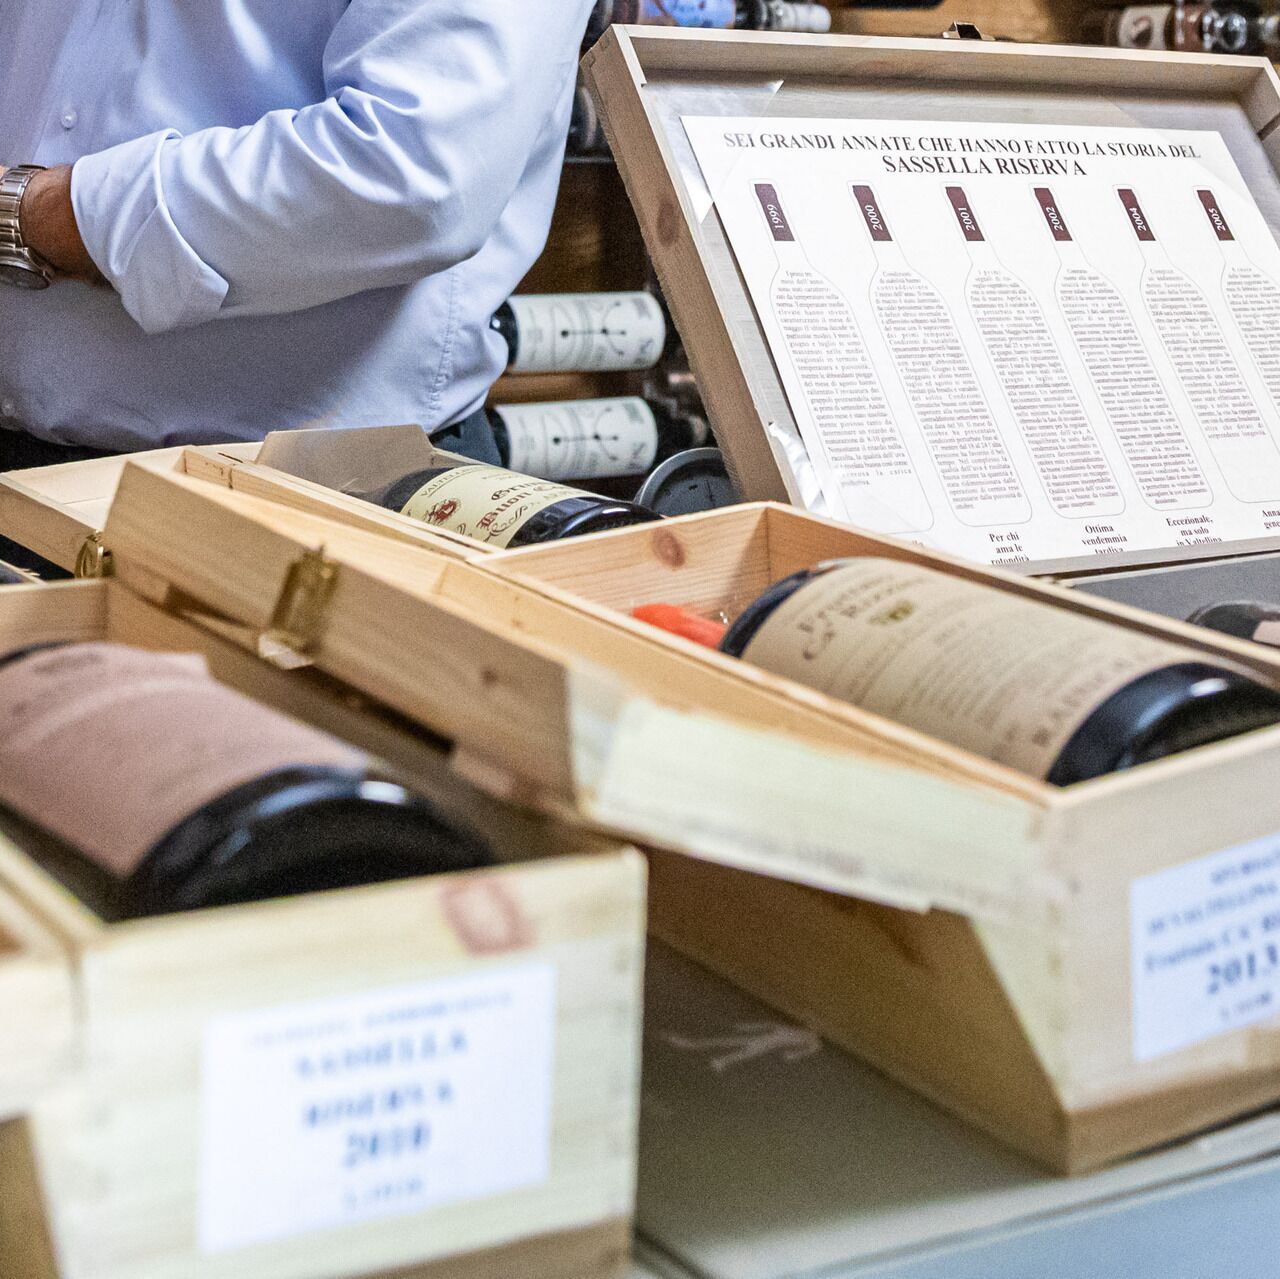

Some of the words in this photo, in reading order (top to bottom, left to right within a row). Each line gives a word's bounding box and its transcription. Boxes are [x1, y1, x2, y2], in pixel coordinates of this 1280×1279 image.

[723, 133, 755, 148] SEI
[760, 133, 835, 150] GRANDI
[841, 135, 915, 151] ANNATE
[918, 137, 956, 152] CHE
[959, 138, 1021, 154] HANNO
[1024, 139, 1080, 155] FATTO
[1083, 141, 1107, 156] LA
[1107, 143, 1169, 158] STORIA
[1169, 144, 1201, 159] DEL
[882, 155, 993, 174] SASSELLA
[994, 158, 1087, 176] RISERVA
[767, 204, 785, 230] 1999
[864, 205, 882, 231] 2000
[958, 207, 976, 231] 2001
[1045, 206, 1064, 231] 2002
[1128, 207, 1147, 231] 2004
[1208, 207, 1226, 231] 2005
[989, 532, 1005, 543] Per
[1006, 531, 1020, 542] chi
[1082, 533, 1128, 546] vendemmia
[1085, 523, 1114, 534] Ottima
[1194, 526, 1210, 535] solo
[996, 545, 1011, 554] ama
[1013, 543, 1023, 552] le
